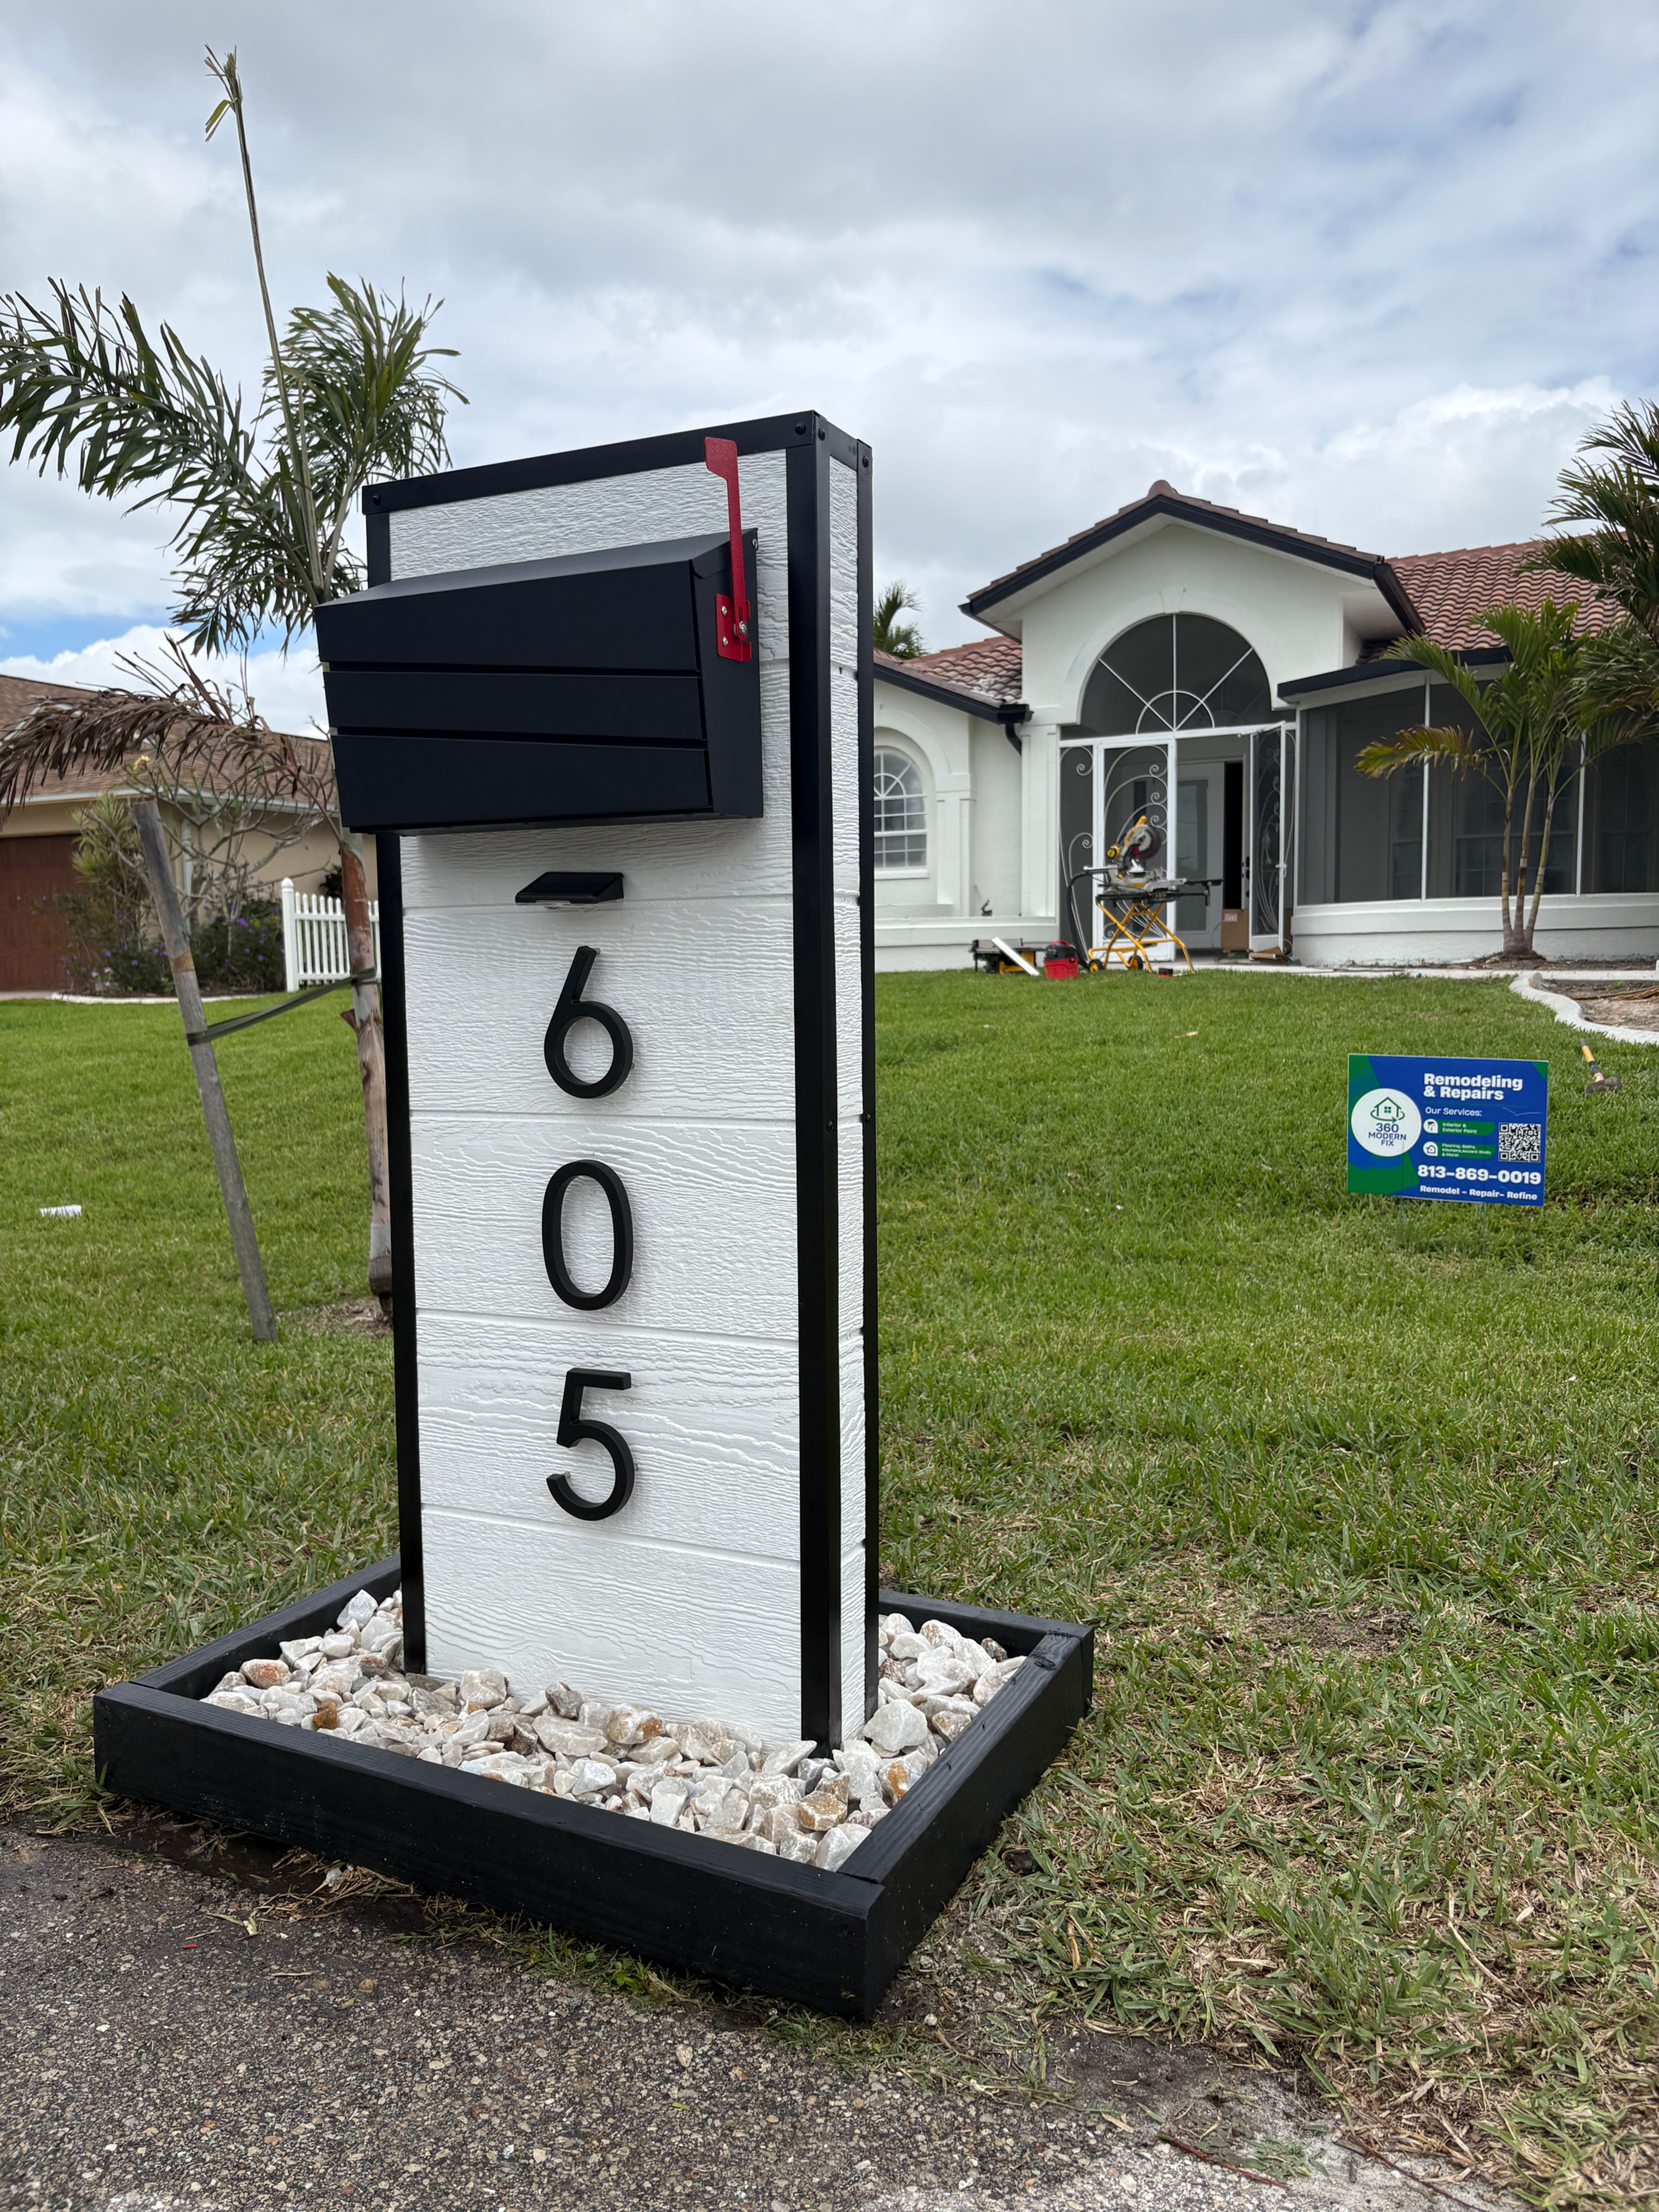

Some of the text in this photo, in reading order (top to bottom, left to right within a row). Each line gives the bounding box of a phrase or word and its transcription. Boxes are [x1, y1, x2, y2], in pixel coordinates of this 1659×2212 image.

[1424, 1073, 1523, 1091] Remodeling
[1423, 1085, 1504, 1101] & Repairs
[1443, 1108, 1482, 1116] Services:
[1376, 1123, 1399, 1132] 360
[1368, 1132, 1407, 1140] MODERN
[1417, 1164, 1541, 1184] 813-869-0019
[1420, 1185, 1460, 1195] Remodel
[1507, 1192, 1537, 1200] Refine
